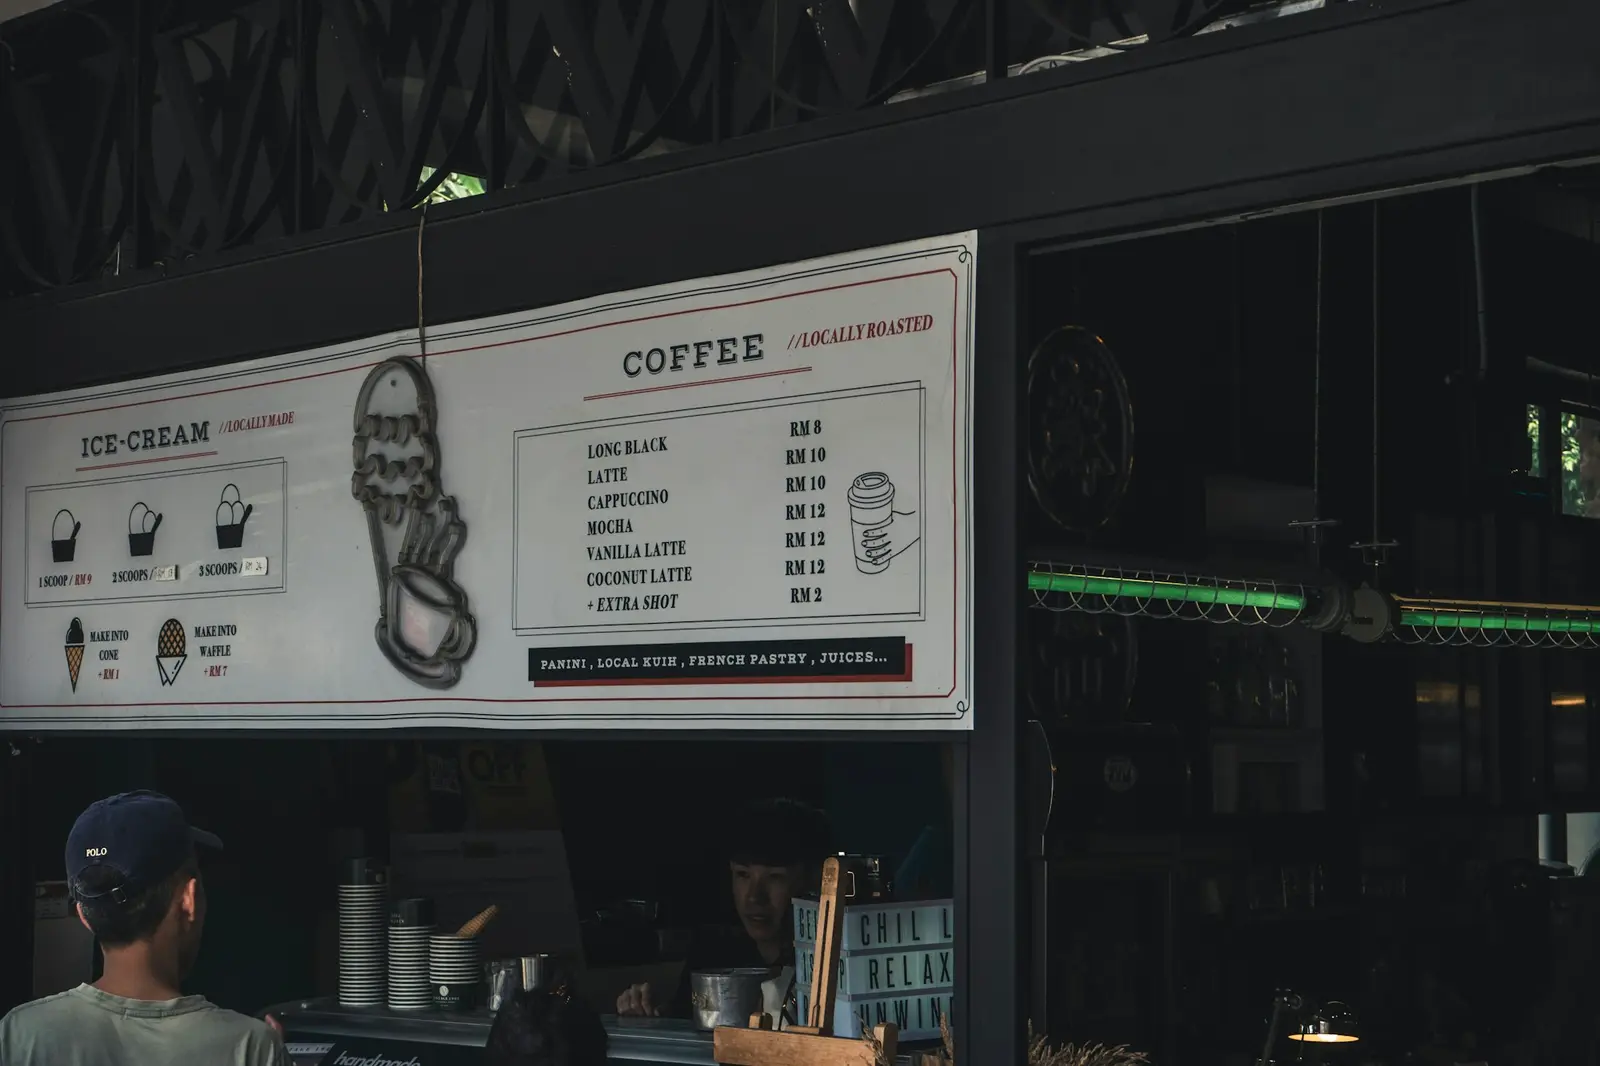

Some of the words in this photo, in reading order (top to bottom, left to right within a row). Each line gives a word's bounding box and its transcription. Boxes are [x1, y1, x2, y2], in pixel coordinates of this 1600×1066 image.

[867, 314, 933, 337] ROASTED
[623, 334, 765, 377] COFFEE
[267, 412, 294, 426] MADE
[790, 421, 810, 437] RM
[814, 420, 821, 434] 8
[81, 421, 210, 458] ICE-CREAM
[588, 442, 622, 459] LONG
[625, 436, 668, 454] BLACK
[786, 449, 806, 464] RM
[811, 448, 826, 462] 10
[588, 468, 628, 484] LATTE
[786, 477, 806, 492] RM
[811, 475, 826, 490] 10
[588, 489, 669, 510] CAPPUCCINO
[786, 505, 806, 520] RM
[811, 504, 825, 518] 12
[587, 519, 633, 536] MOCHA
[786, 533, 806, 548] RM
[810, 532, 825, 546] 12
[587, 543, 641, 560] VANILLA
[645, 541, 686, 557] LATTE
[112, 572, 117, 583] 2
[118, 569, 148, 582] SCOOPS
[199, 565, 204, 577] 3
[205, 562, 237, 576] SCOOPS
[785, 561, 805, 576] RM
[810, 560, 825, 574] 12
[39, 577, 42, 588] 1
[44, 575, 68, 587] SCOOP
[74, 575, 87, 586] RM
[87, 574, 92, 584] 9
[587, 569, 647, 587] COCONUT
[651, 567, 692, 583] LATTE
[597, 597, 639, 612] EXTRA
[643, 594, 678, 609] SHOT
[791, 588, 811, 603] RM
[814, 588, 822, 602] 2
[90, 630, 111, 642] MAKE
[112, 630, 129, 641] INTO
[194, 626, 216, 638] MAKE
[218, 625, 237, 637] INTO
[99, 649, 119, 661] CONE
[200, 646, 231, 657] WAFFLE
[540, 659, 587, 670] PANINI
[597, 657, 639, 668] LOCAL
[643, 657, 678, 667] KUIH
[689, 654, 745, 666] FRENCH
[750, 653, 808, 665] PASTRY
[103, 669, 114, 680] RM
[209, 666, 221, 677] RM
[222, 665, 228, 676] 7
[86, 847, 108, 858] POLO
[869, 952, 950, 989] RELAX
